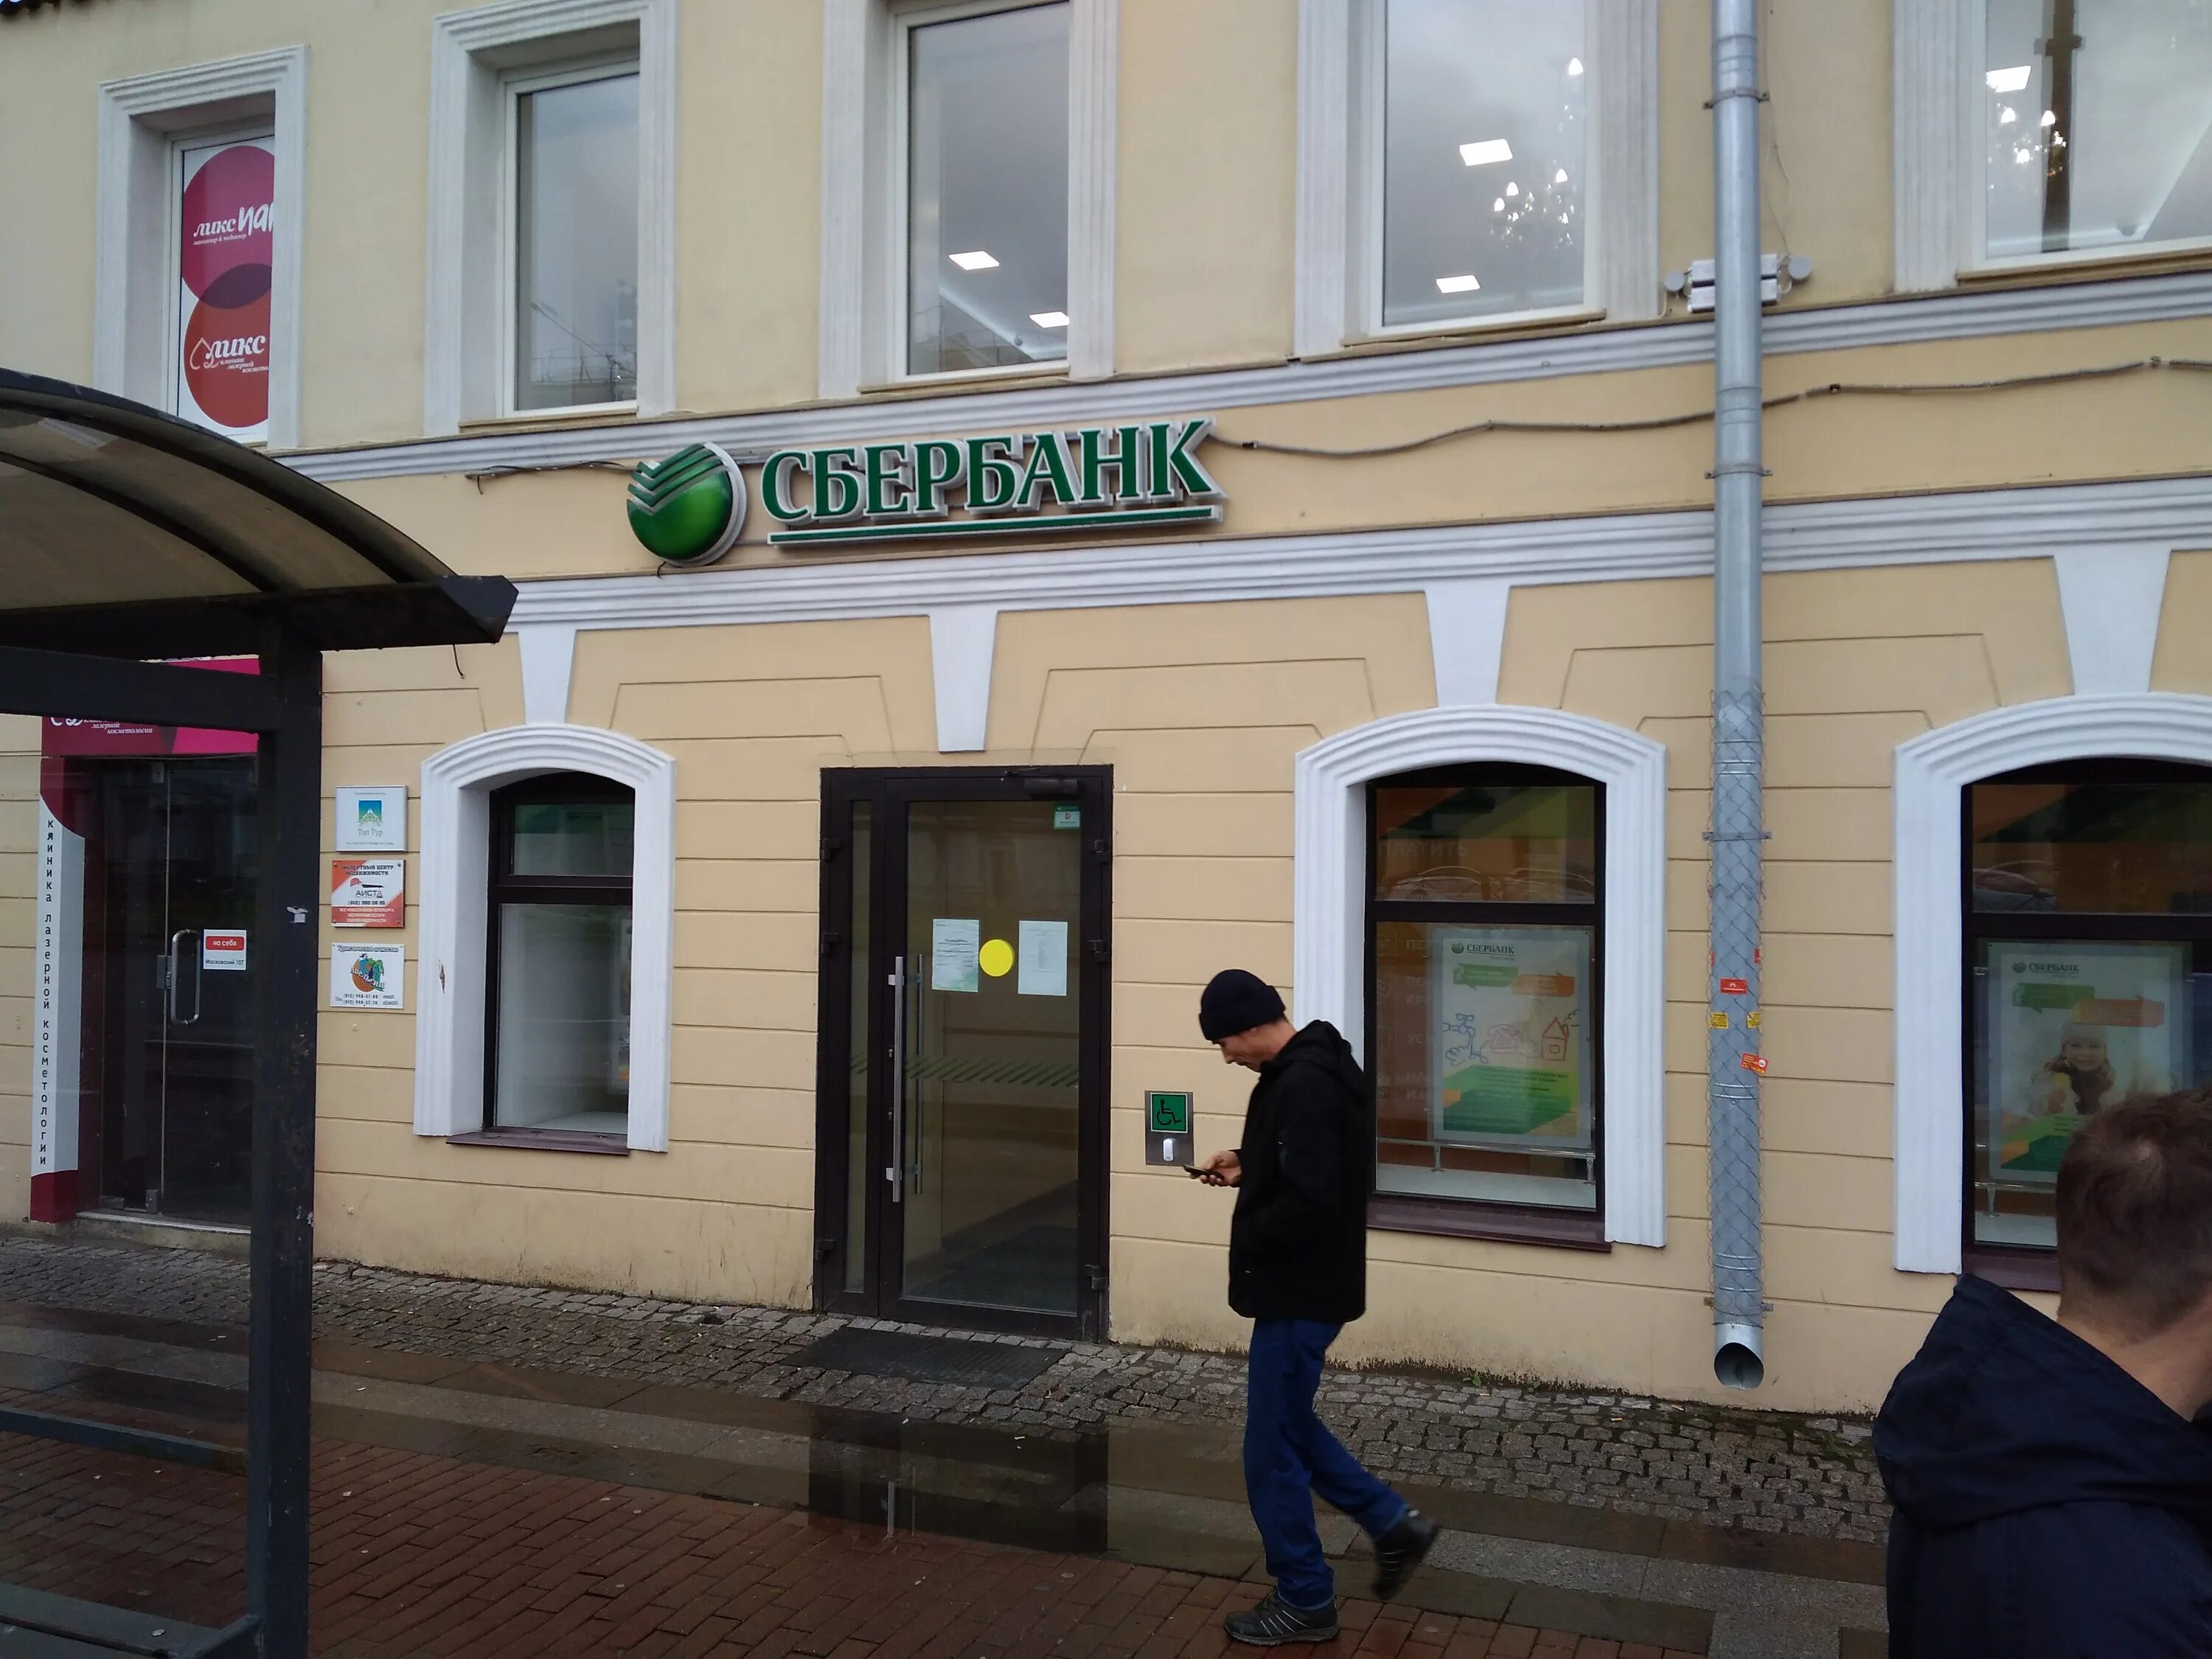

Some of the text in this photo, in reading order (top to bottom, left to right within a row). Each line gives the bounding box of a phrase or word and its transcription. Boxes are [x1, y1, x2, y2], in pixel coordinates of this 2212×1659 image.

[193, 218, 237, 237] ликс
[206, 335, 266, 360] ликс
[760, 417, 1224, 525] СБЕРБАНК
[358, 828, 383, 837] Топ Тур
[1467, 944, 1514, 954] СБЕРБАНК
[2029, 963, 2080, 973] СБЕРБАНК
[39, 819, 55, 1165] клиника лазерной косметологии
